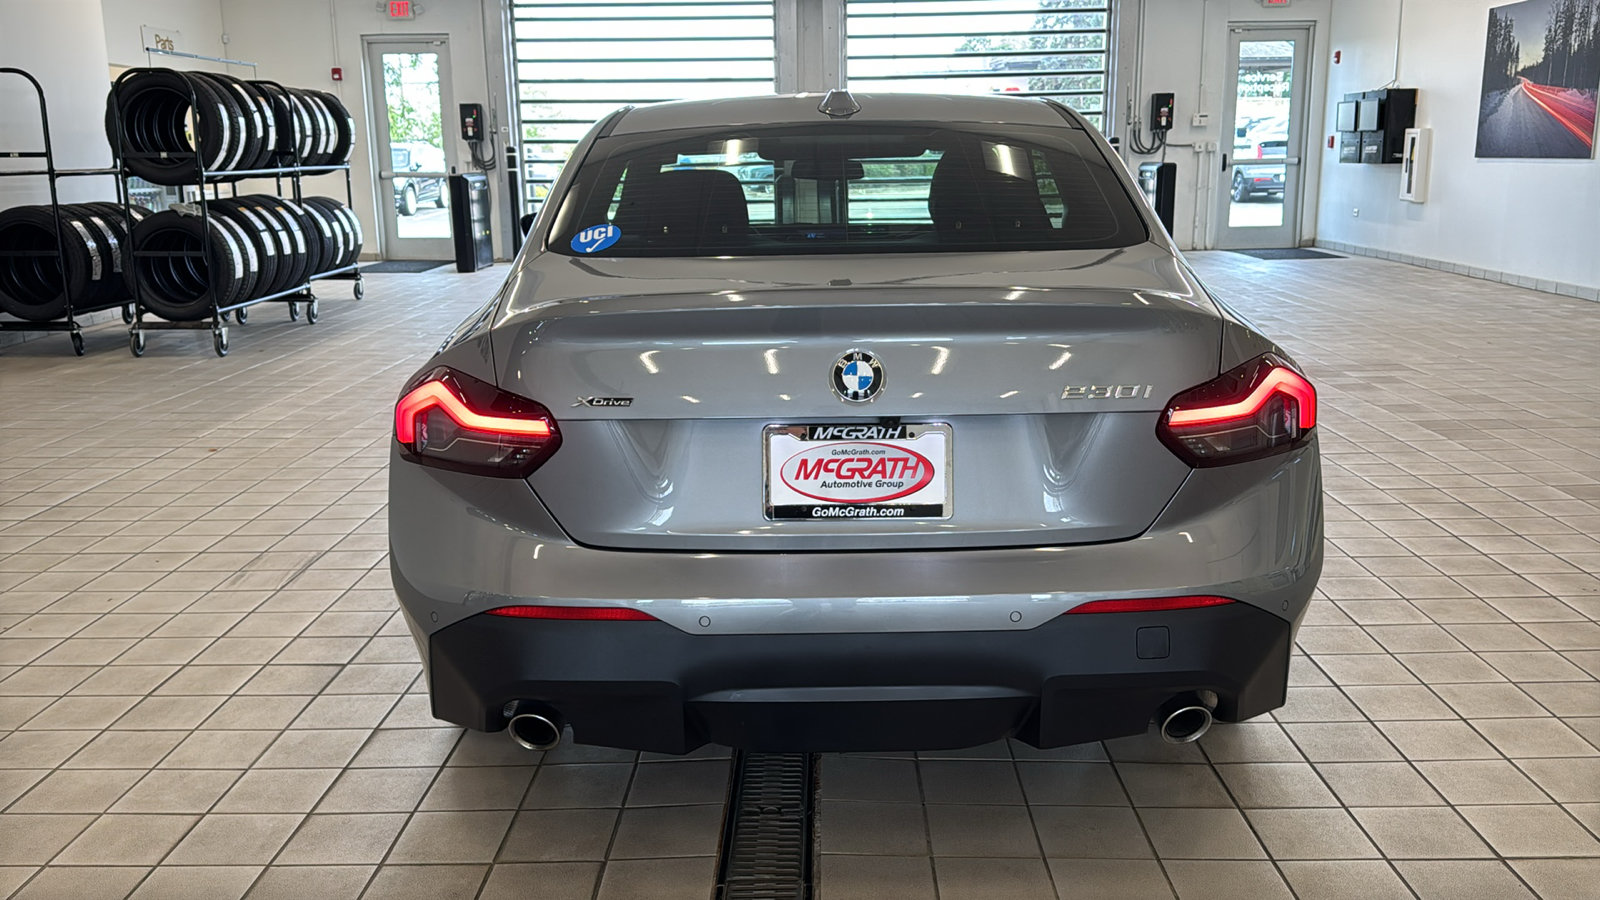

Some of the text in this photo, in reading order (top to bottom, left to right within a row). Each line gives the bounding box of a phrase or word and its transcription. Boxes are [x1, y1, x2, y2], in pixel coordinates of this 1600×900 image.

[390, 1, 409, 17] EXIT
[155, 34, 174, 51] Parts
[580, 226, 613, 243] UCI
[838, 353, 881, 369] BMW
[820, 480, 904, 489] Automotive Group
[812, 506, 905, 518] GoMcGrath.com
